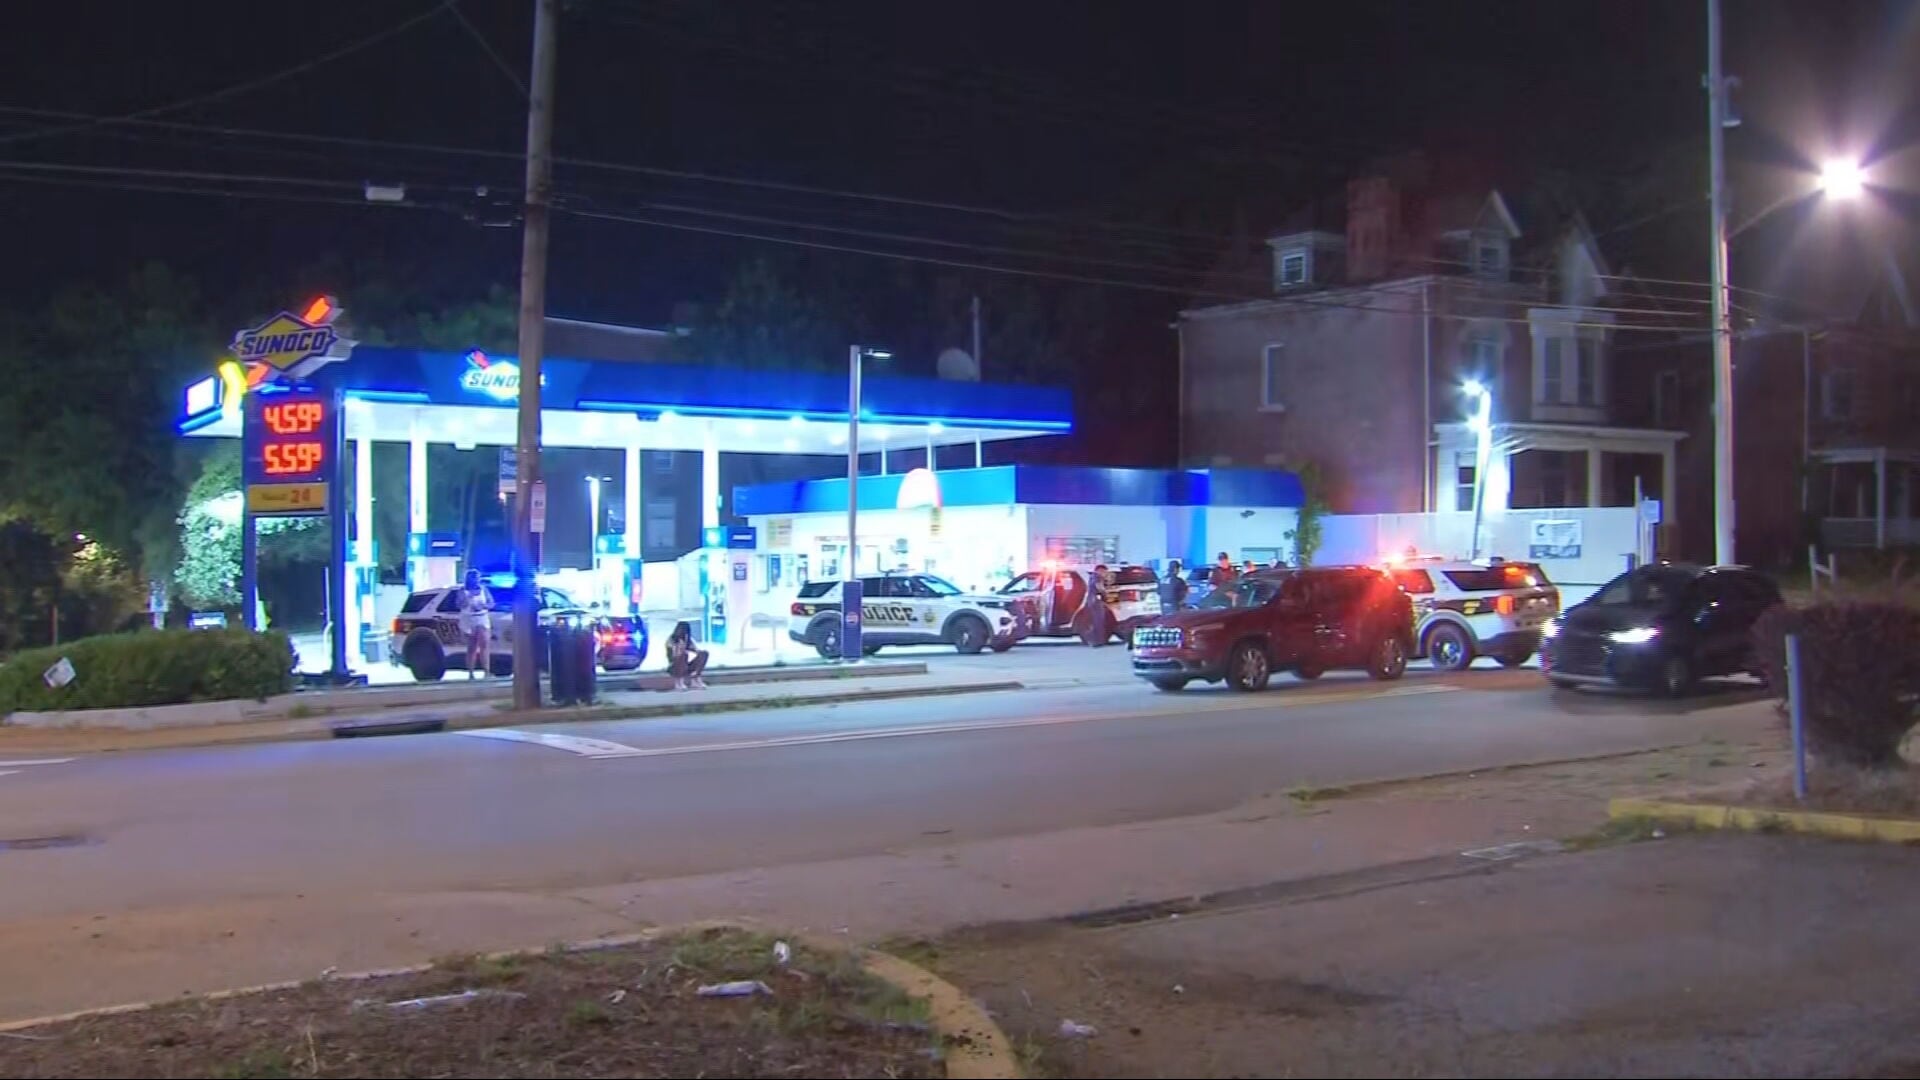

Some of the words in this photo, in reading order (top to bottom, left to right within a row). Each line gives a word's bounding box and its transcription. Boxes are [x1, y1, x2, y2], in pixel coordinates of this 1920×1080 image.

[240, 331, 328, 356] SUNOCO
[469, 373, 520, 388] SUNO
[862, 605, 918, 622] OLICE
